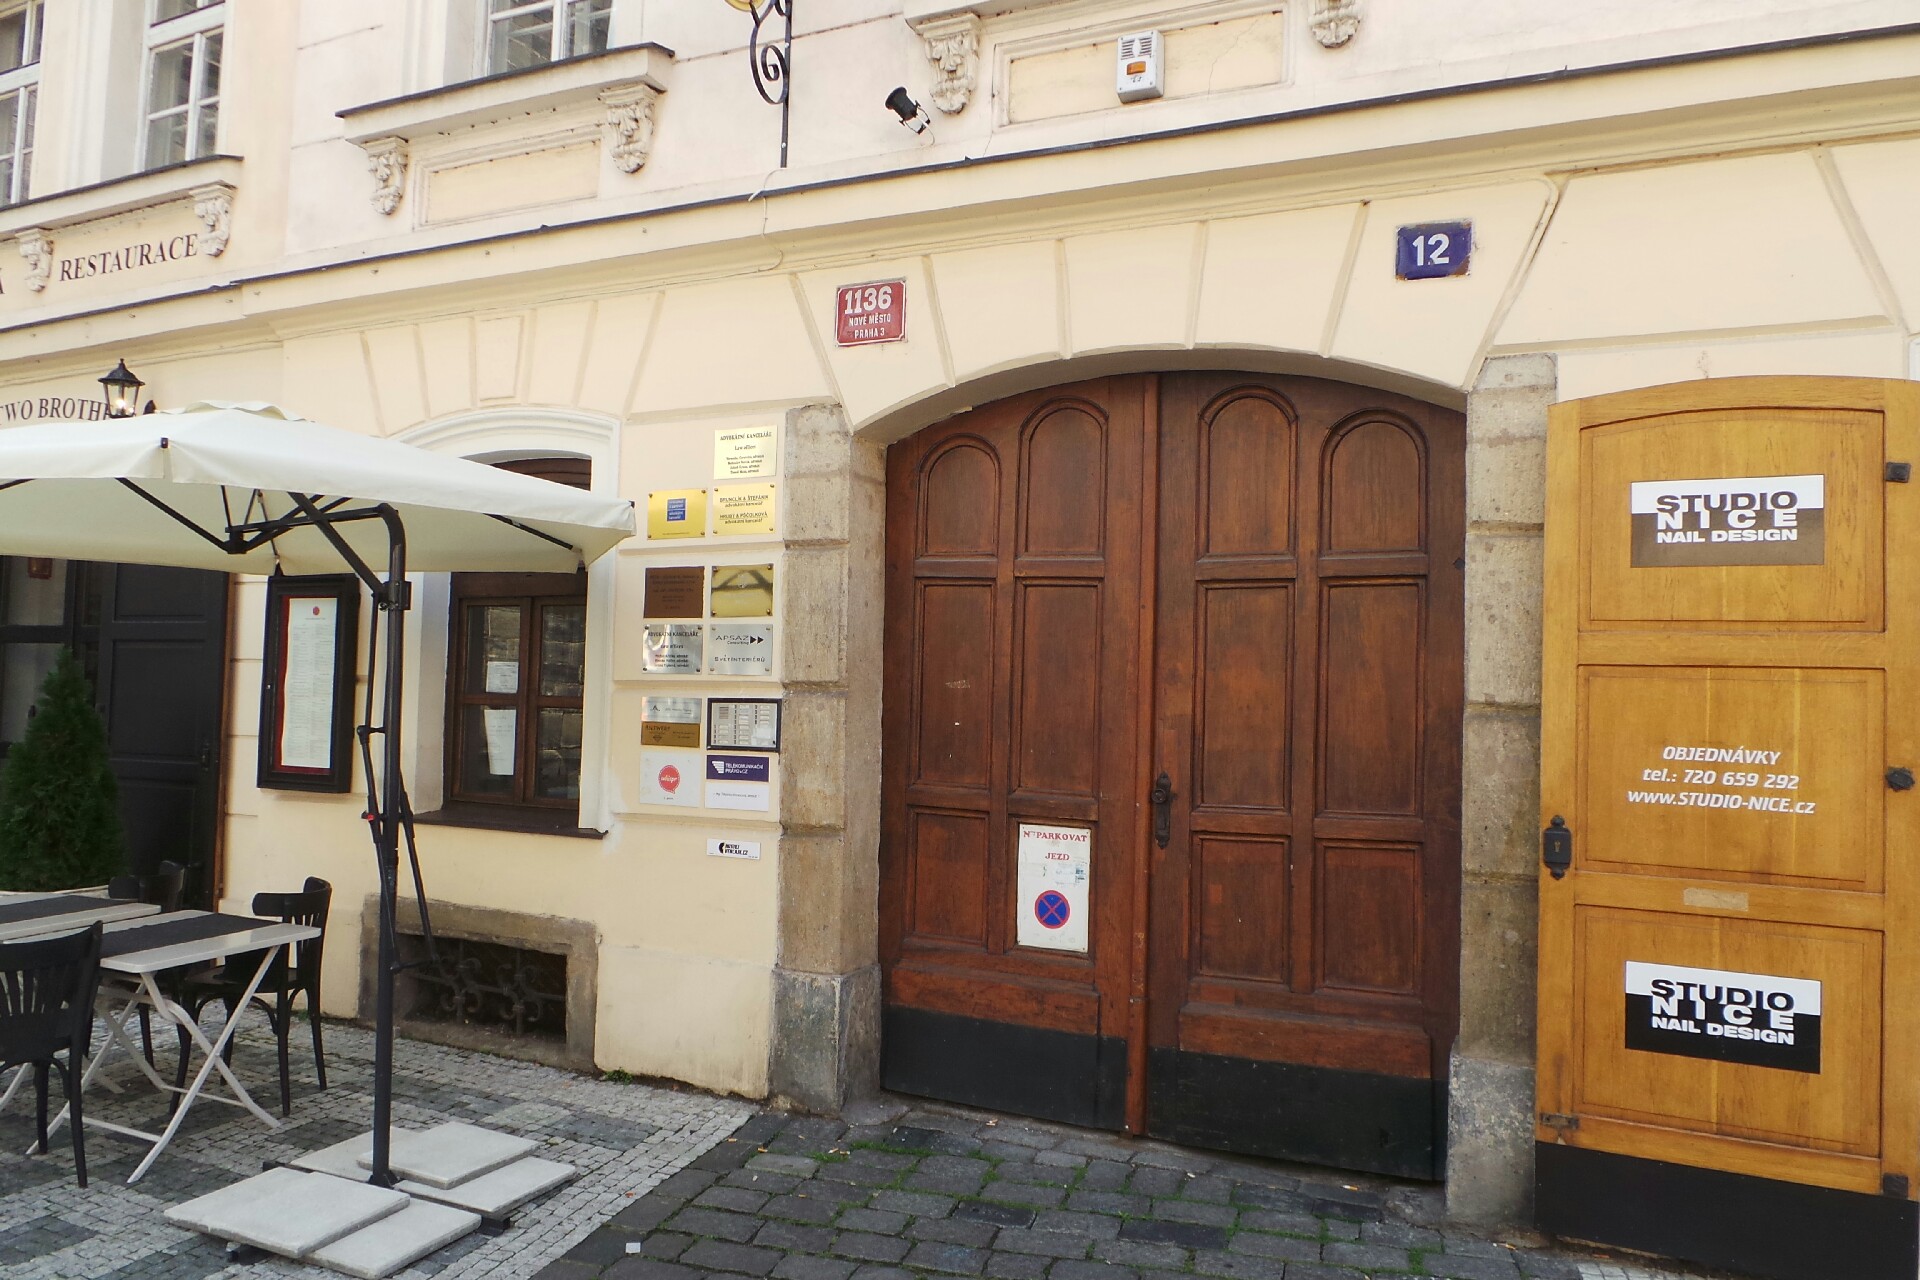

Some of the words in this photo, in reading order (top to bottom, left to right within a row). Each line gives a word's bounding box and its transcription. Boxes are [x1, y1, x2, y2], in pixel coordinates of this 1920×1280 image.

[58, 233, 199, 282] RESTAURACE
[1412, 233, 1450, 266] 12
[844, 285, 892, 315] 1136
[848, 314, 867, 327] NOVÉ
[868, 312, 891, 324] MĚSTO
[854, 328, 879, 339] PRAHA
[880, 327, 885, 336] 3
[1656, 491, 1798, 513] STUDIO
[1656, 509, 1798, 530] NICE
[1657, 530, 1706, 544] NAIL
[1711, 528, 1798, 542] DESIGN
[1662, 746, 1781, 766] OBJEDNÁVKY
[1642, 768, 1677, 783] tel.:
[1683, 769, 1717, 784] 720
[1722, 772, 1759, 787] 659
[1763, 774, 1800, 790] 292
[1045, 852, 1070, 861] JEZD
[1650, 979, 1795, 1012] STUDIO
[1651, 997, 1795, 1031] NICE
[1652, 1016, 1701, 1034] NAIL
[1706, 1022, 1795, 1046] DESIGN
